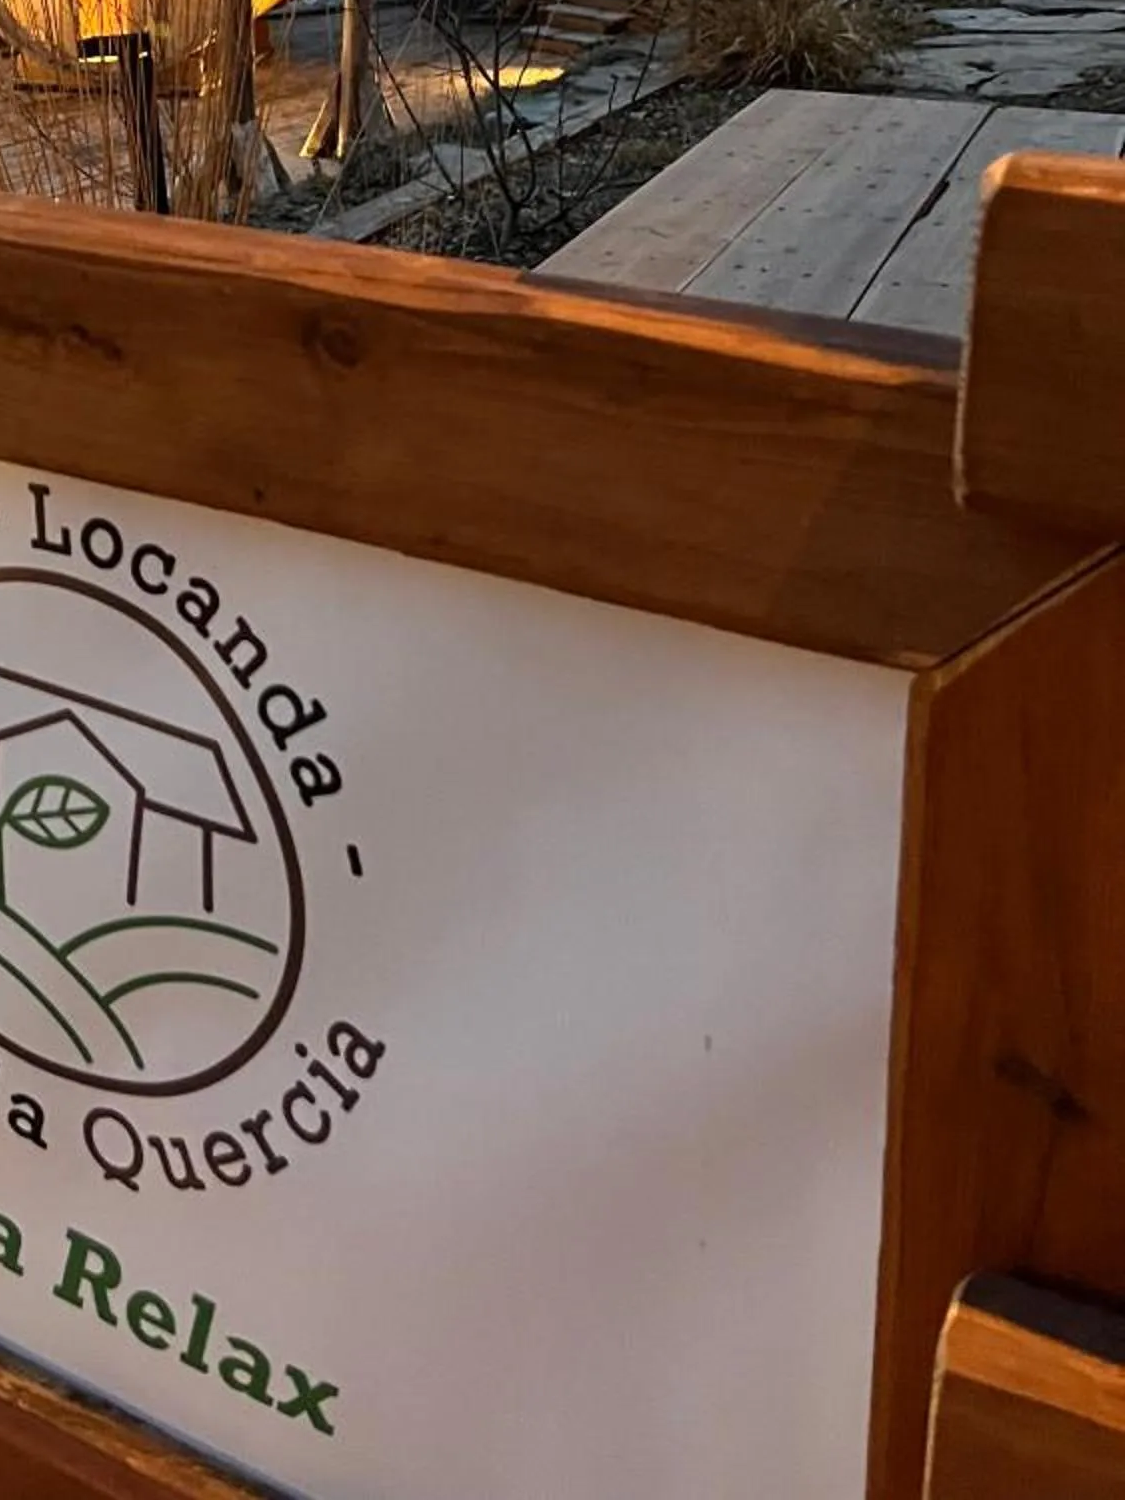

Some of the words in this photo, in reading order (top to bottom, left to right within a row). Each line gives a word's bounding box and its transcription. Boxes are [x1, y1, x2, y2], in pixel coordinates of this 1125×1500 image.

[26, 481, 344, 810] Locanda
[81, 1019, 388, 1195] Quercia
[51, 1226, 341, 1438] Relax
